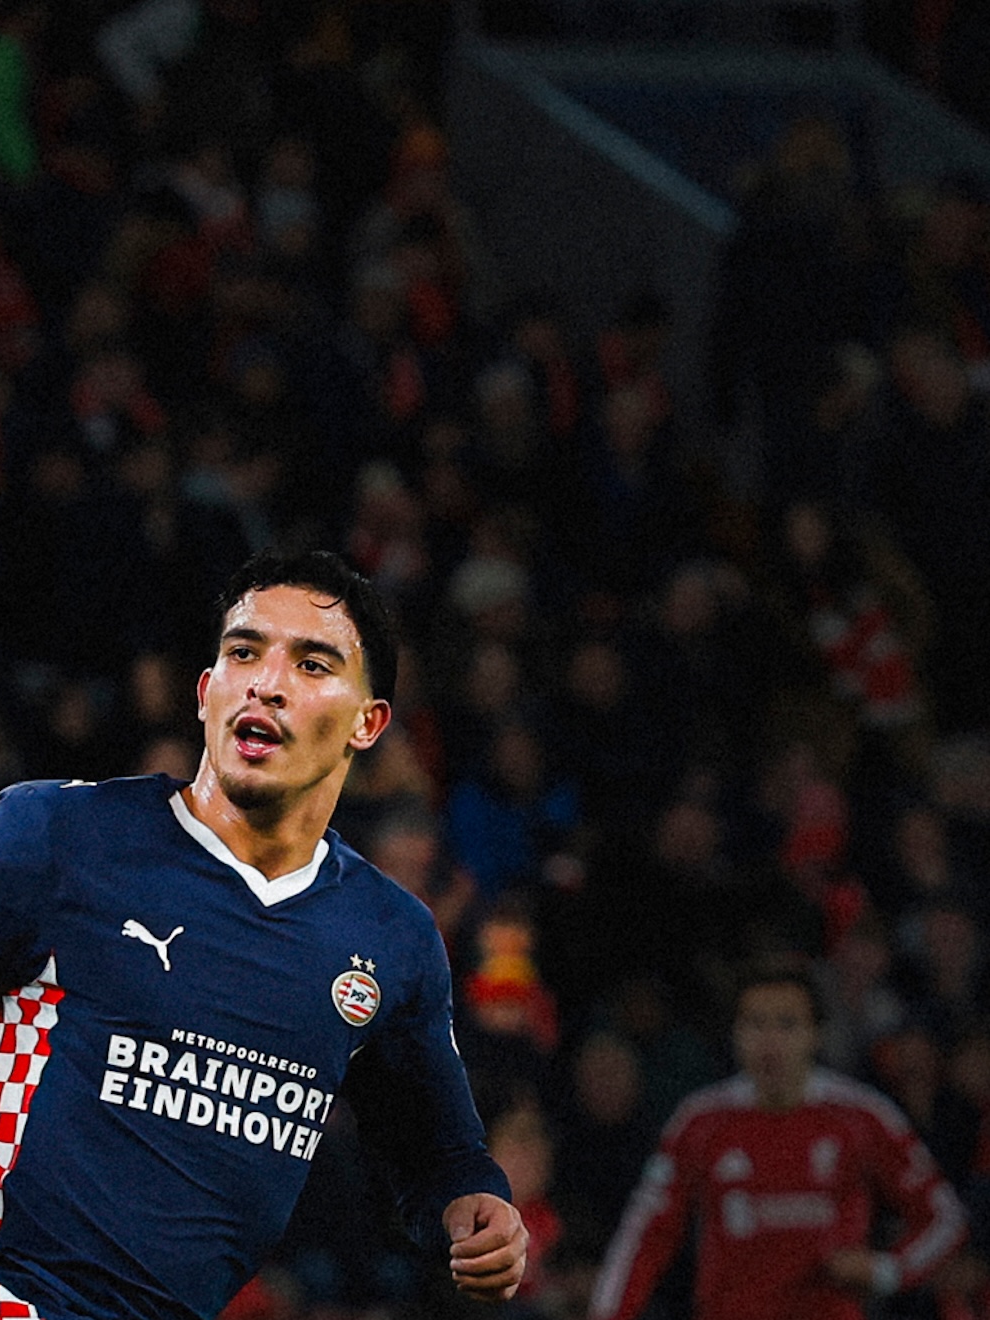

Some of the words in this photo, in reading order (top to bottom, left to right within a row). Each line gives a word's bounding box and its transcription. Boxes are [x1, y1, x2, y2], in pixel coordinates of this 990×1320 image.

[107, 1034, 334, 1124] BRAINPORT
[170, 1028, 318, 1080] METROPOOLREGIO
[99, 1069, 324, 1162] EINDHOVEN
